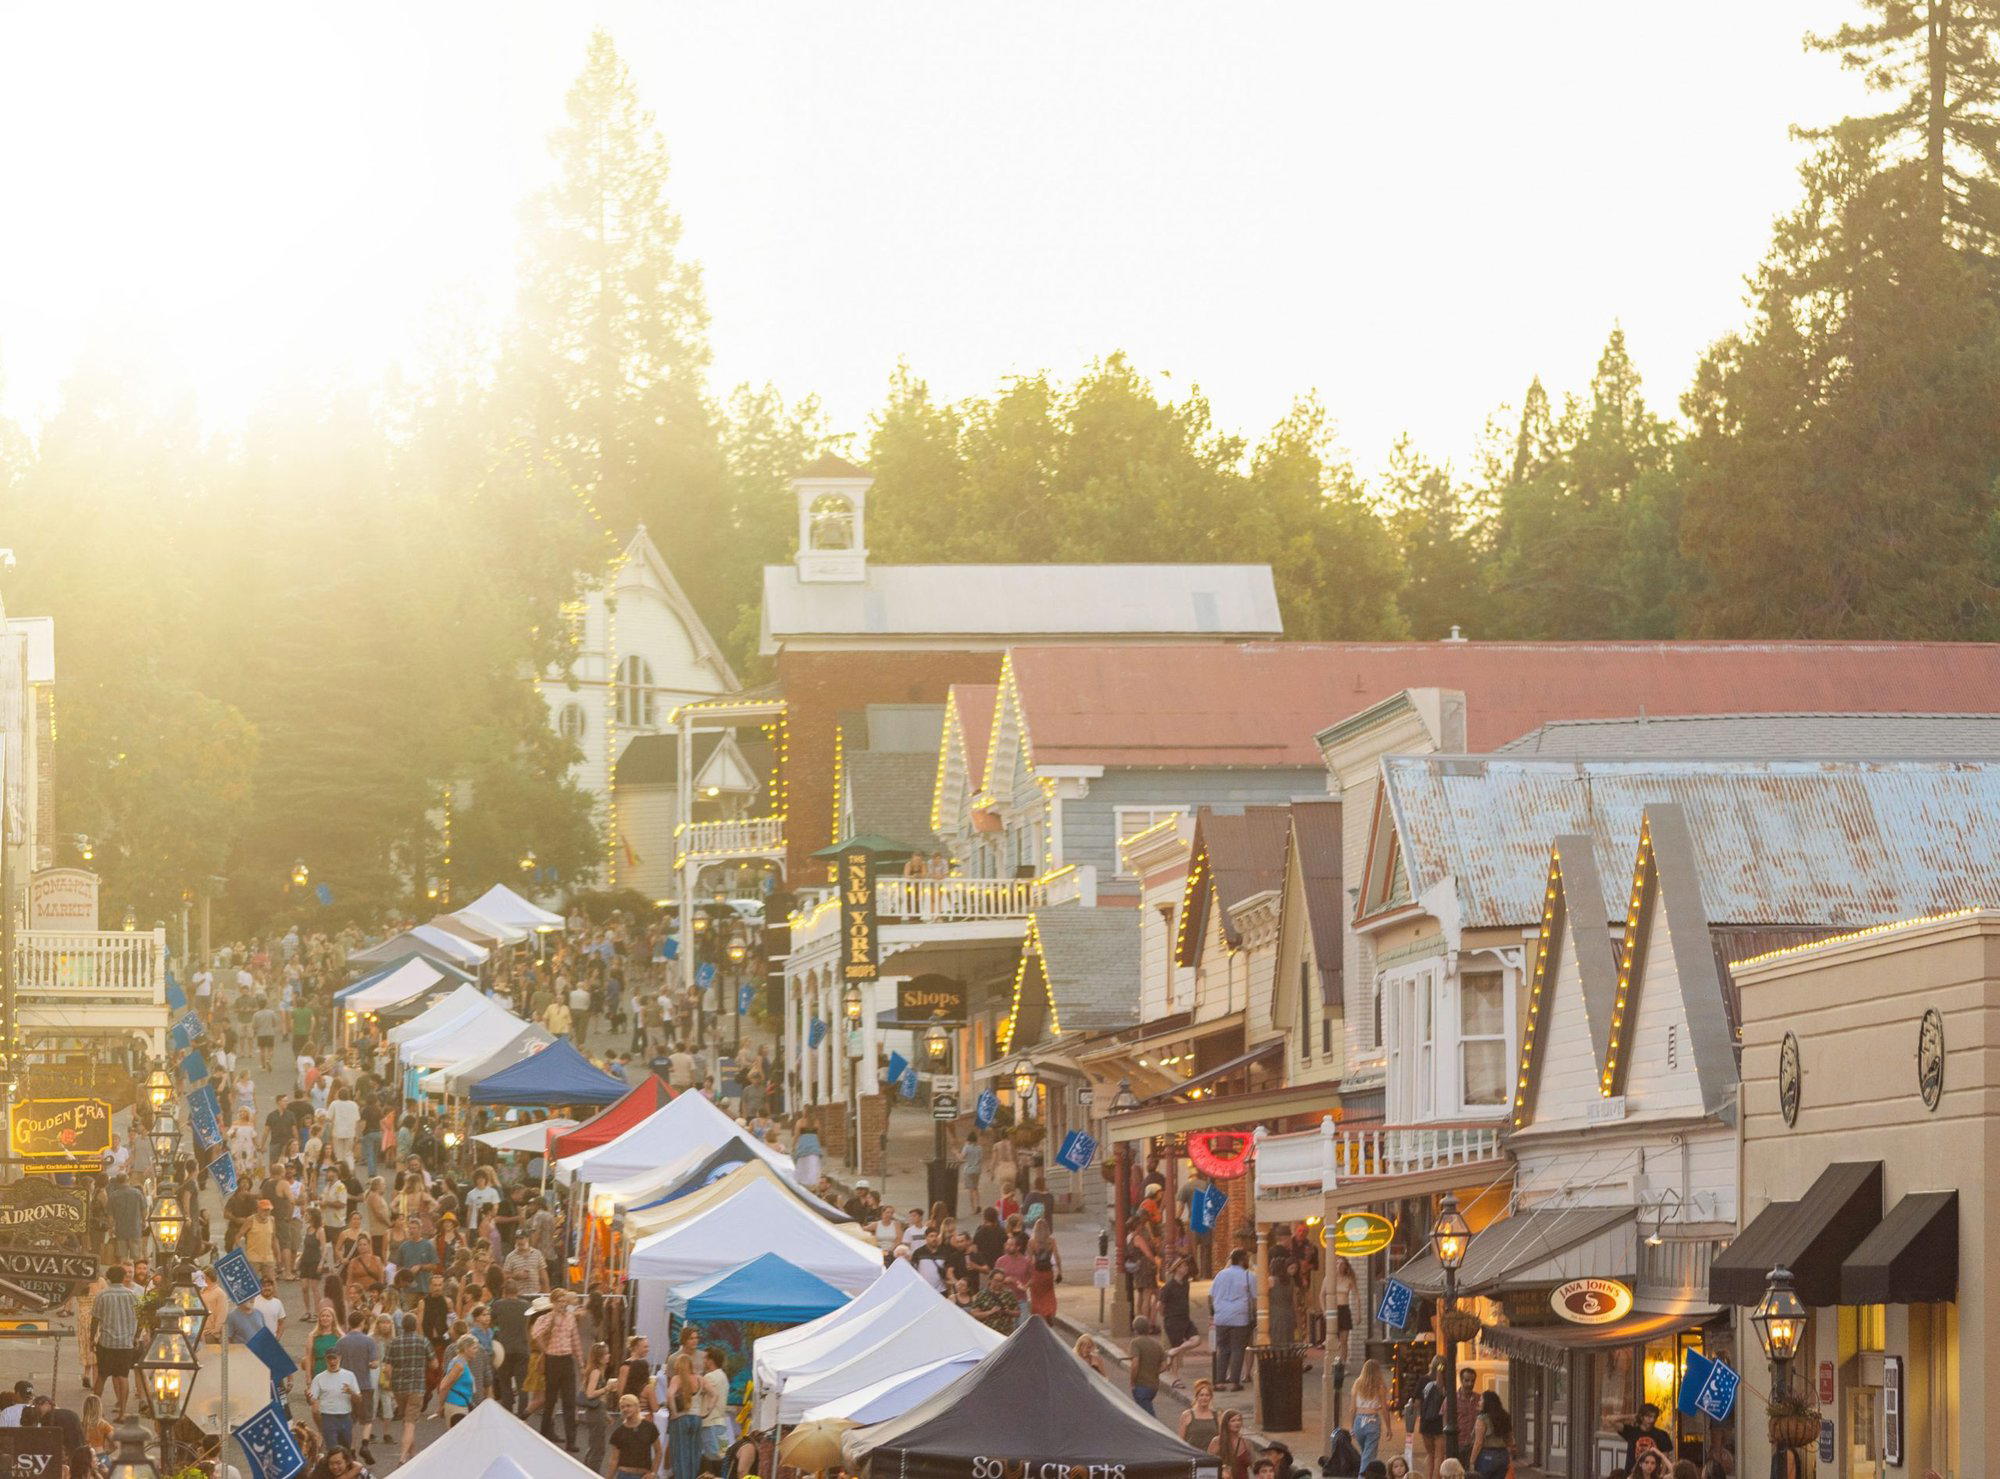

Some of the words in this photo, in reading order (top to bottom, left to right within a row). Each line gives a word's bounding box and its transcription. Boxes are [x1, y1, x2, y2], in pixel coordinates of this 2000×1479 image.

[847, 865, 871, 905] NEW
[37, 903, 93, 917] MARKET
[849, 911, 870, 963] YORK
[903, 990, 961, 1007] Shops
[16, 1109, 72, 1144] GOLDEN
[73, 1104, 106, 1130] ERA
[20, 1280, 66, 1293] MEN'S
[1559, 1282, 1583, 1299] JAVA
[1586, 1280, 1621, 1298] JOHN'S
[12, 1454, 53, 1474] sy
